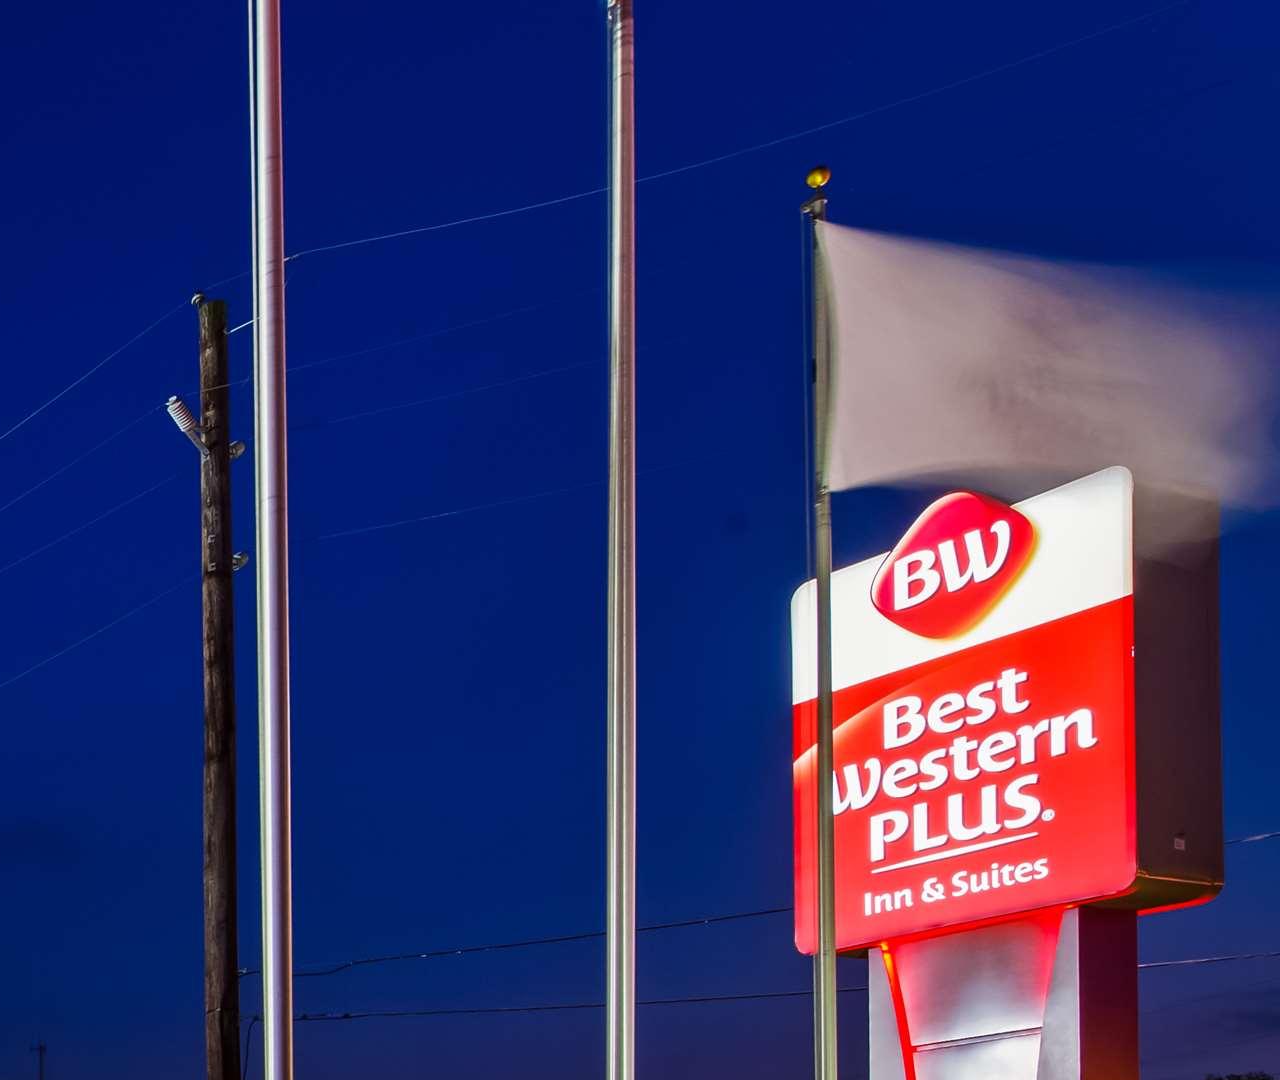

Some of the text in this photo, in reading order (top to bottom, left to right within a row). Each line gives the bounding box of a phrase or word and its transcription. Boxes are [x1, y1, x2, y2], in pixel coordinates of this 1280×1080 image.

[893, 521, 1010, 611] BW
[882, 669, 1029, 750] Best
[833, 708, 1097, 815] Western
[864, 857, 1049, 916] Inn & Suites
